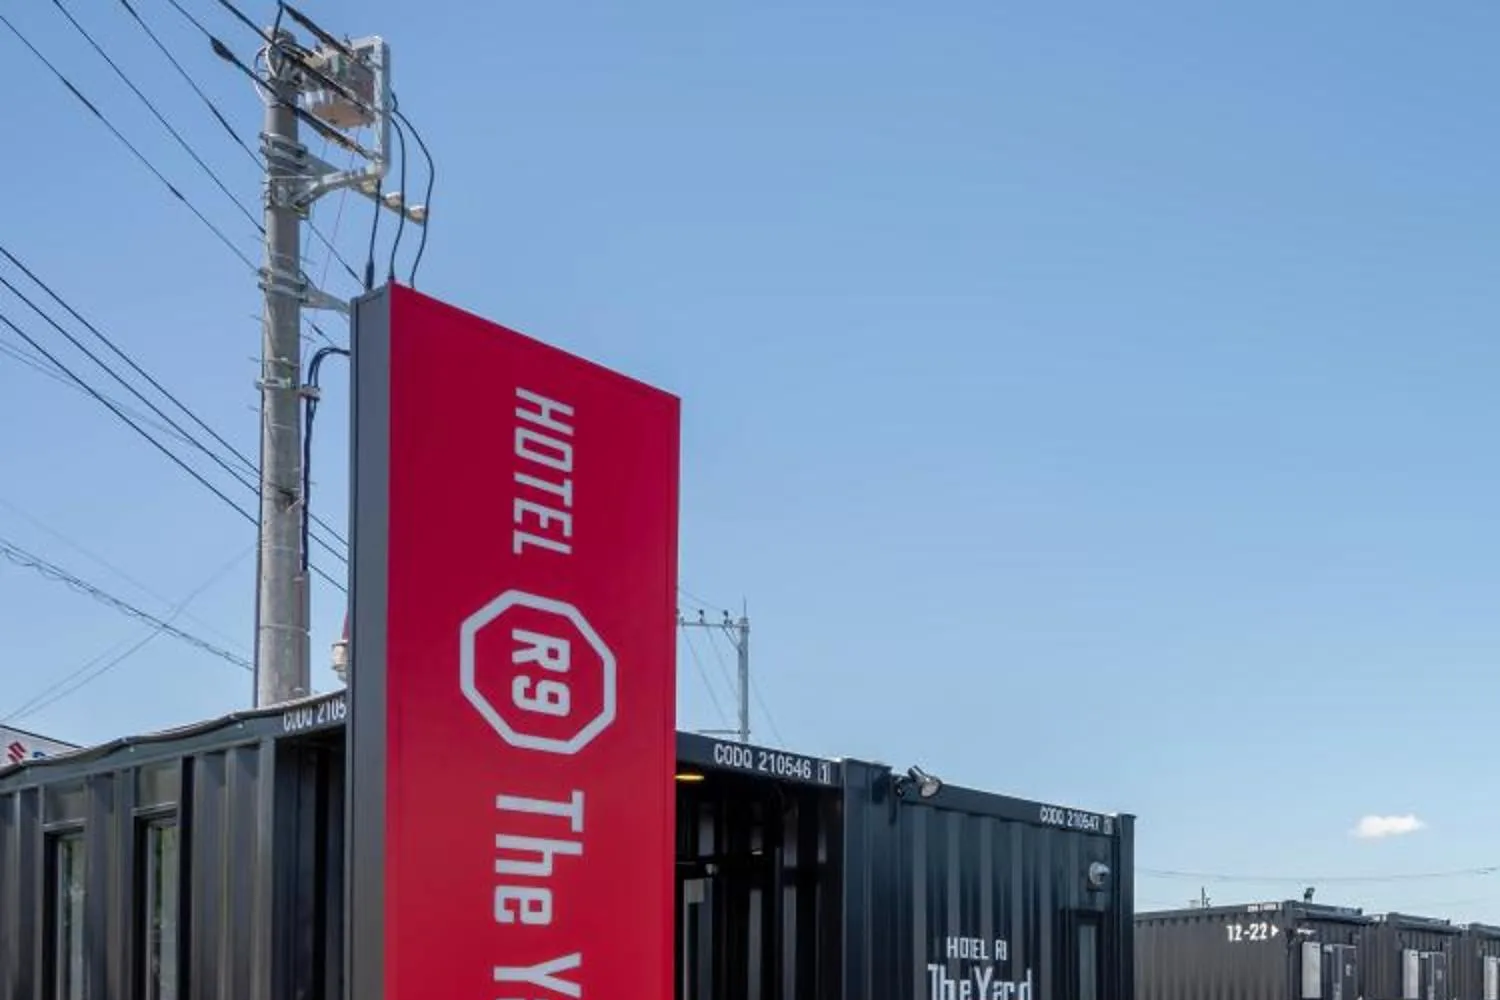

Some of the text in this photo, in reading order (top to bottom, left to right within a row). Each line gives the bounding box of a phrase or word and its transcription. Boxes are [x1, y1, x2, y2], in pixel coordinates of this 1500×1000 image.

[513, 386, 576, 557] HOTEL
[510, 627, 572, 718] R9
[713, 743, 753, 769] CODQ
[758, 751, 812, 779] 210546
[493, 789, 585, 927] The
[1225, 922, 1268, 942] 12-22
